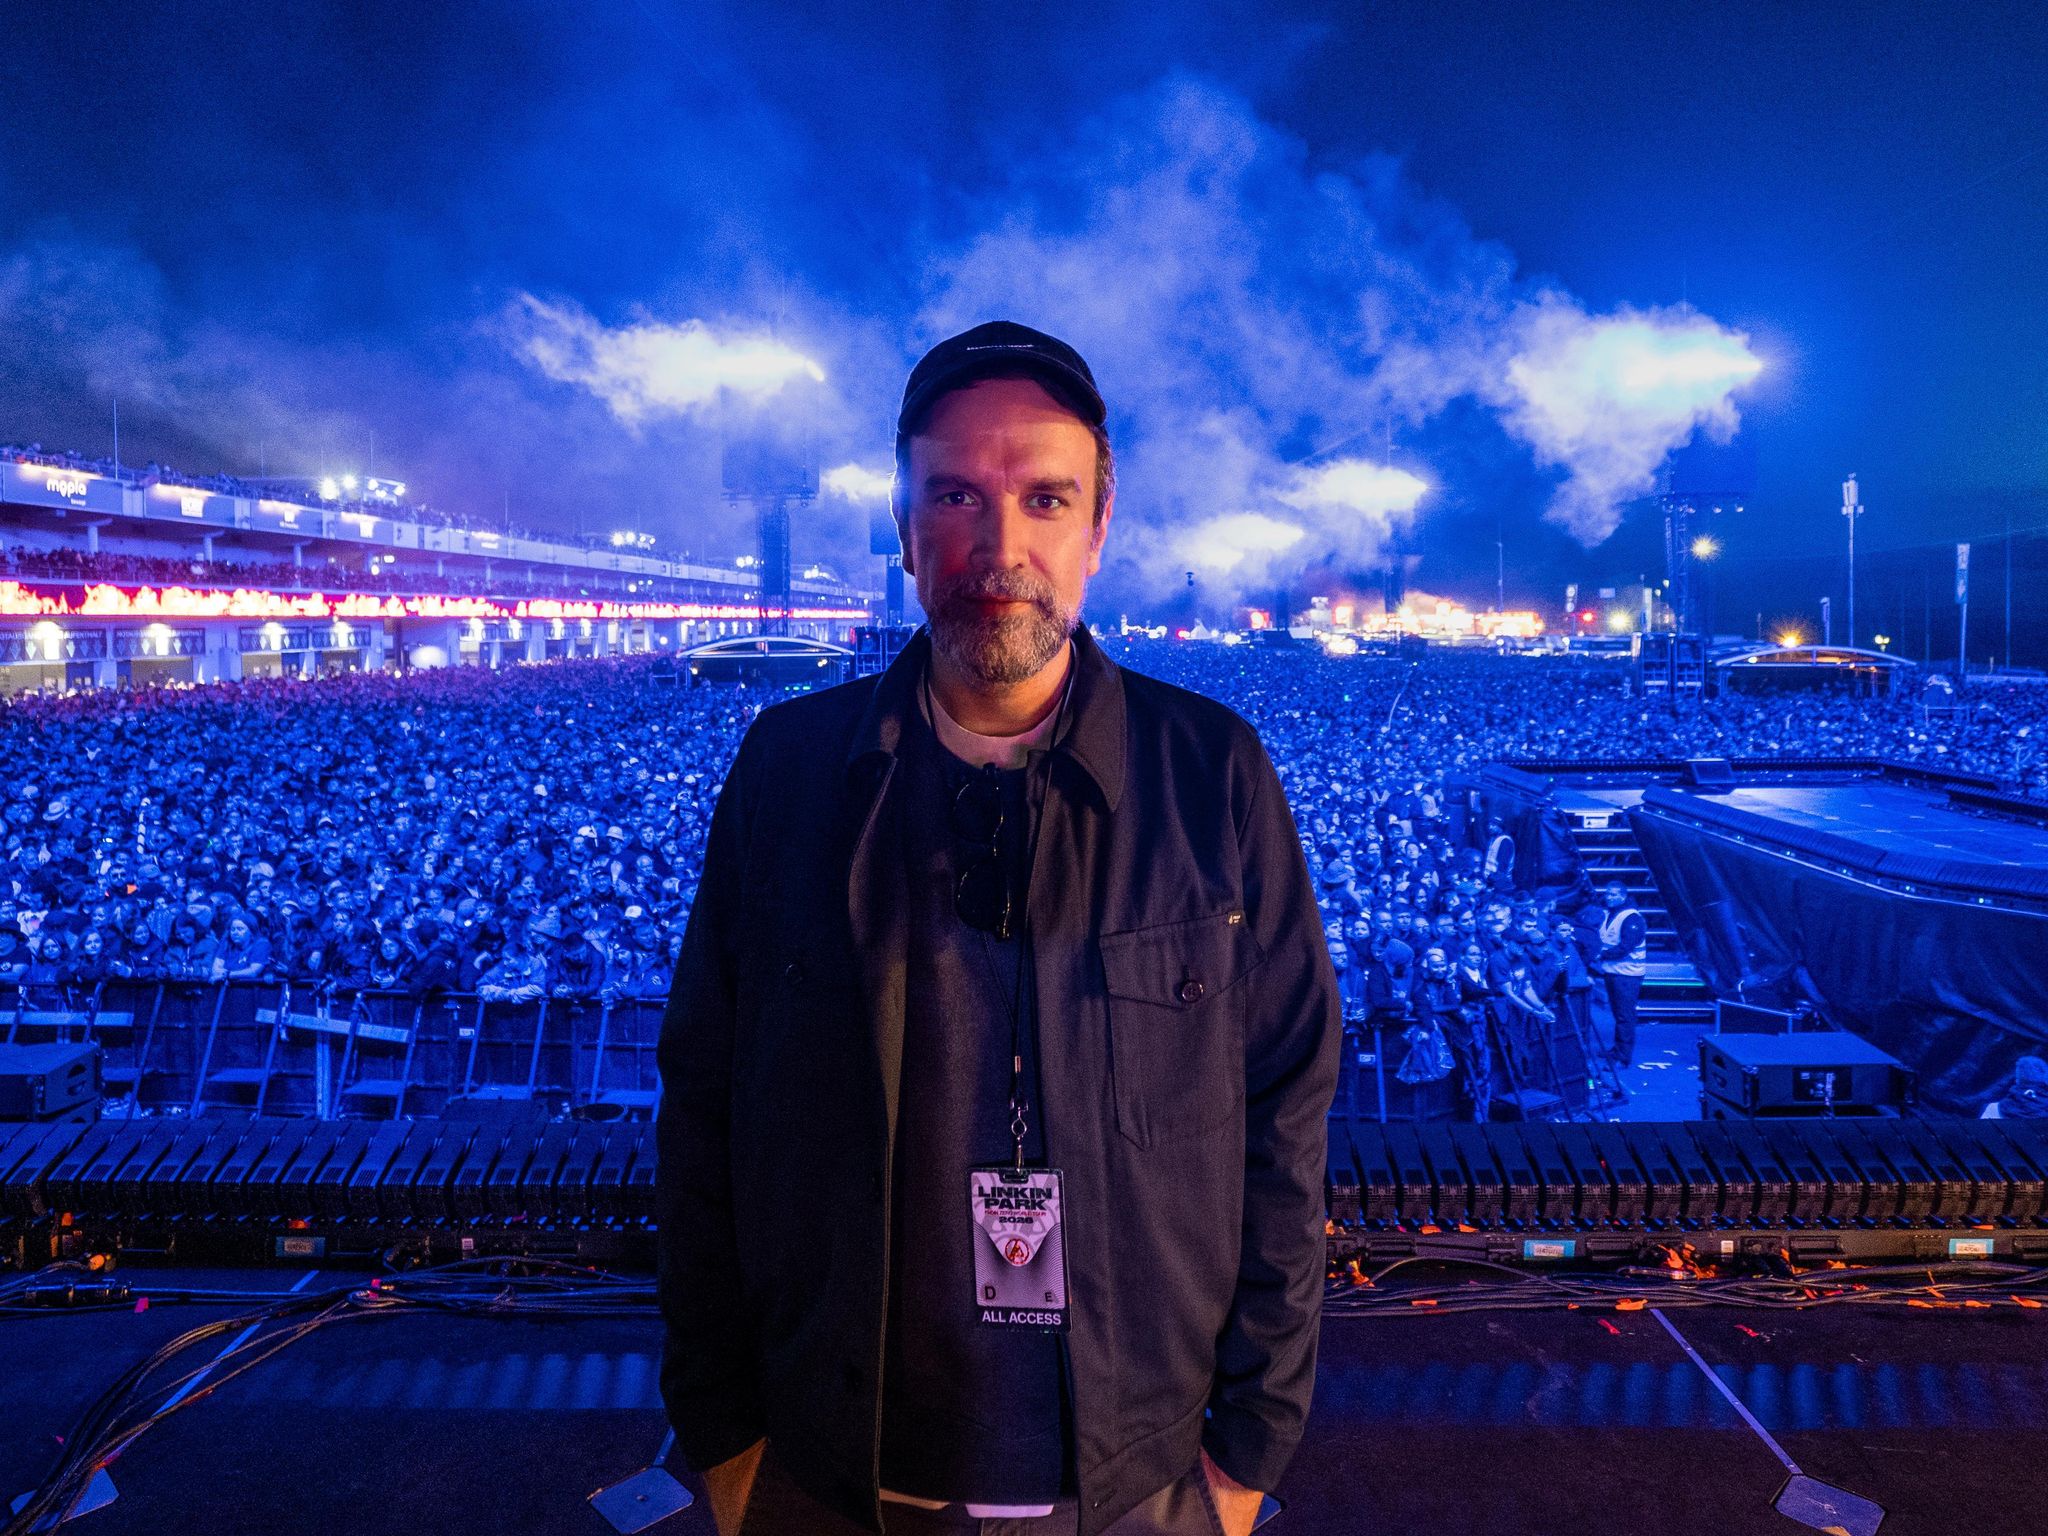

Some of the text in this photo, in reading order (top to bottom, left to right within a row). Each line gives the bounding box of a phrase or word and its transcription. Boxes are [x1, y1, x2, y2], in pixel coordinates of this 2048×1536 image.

[978, 1187, 1052, 1199] LINKIN
[984, 1199, 1047, 1211] PARK
[984, 1286, 996, 1300] D
[1045, 1292, 1053, 1302] E
[982, 1311, 1062, 1325] ALL ACCESS
